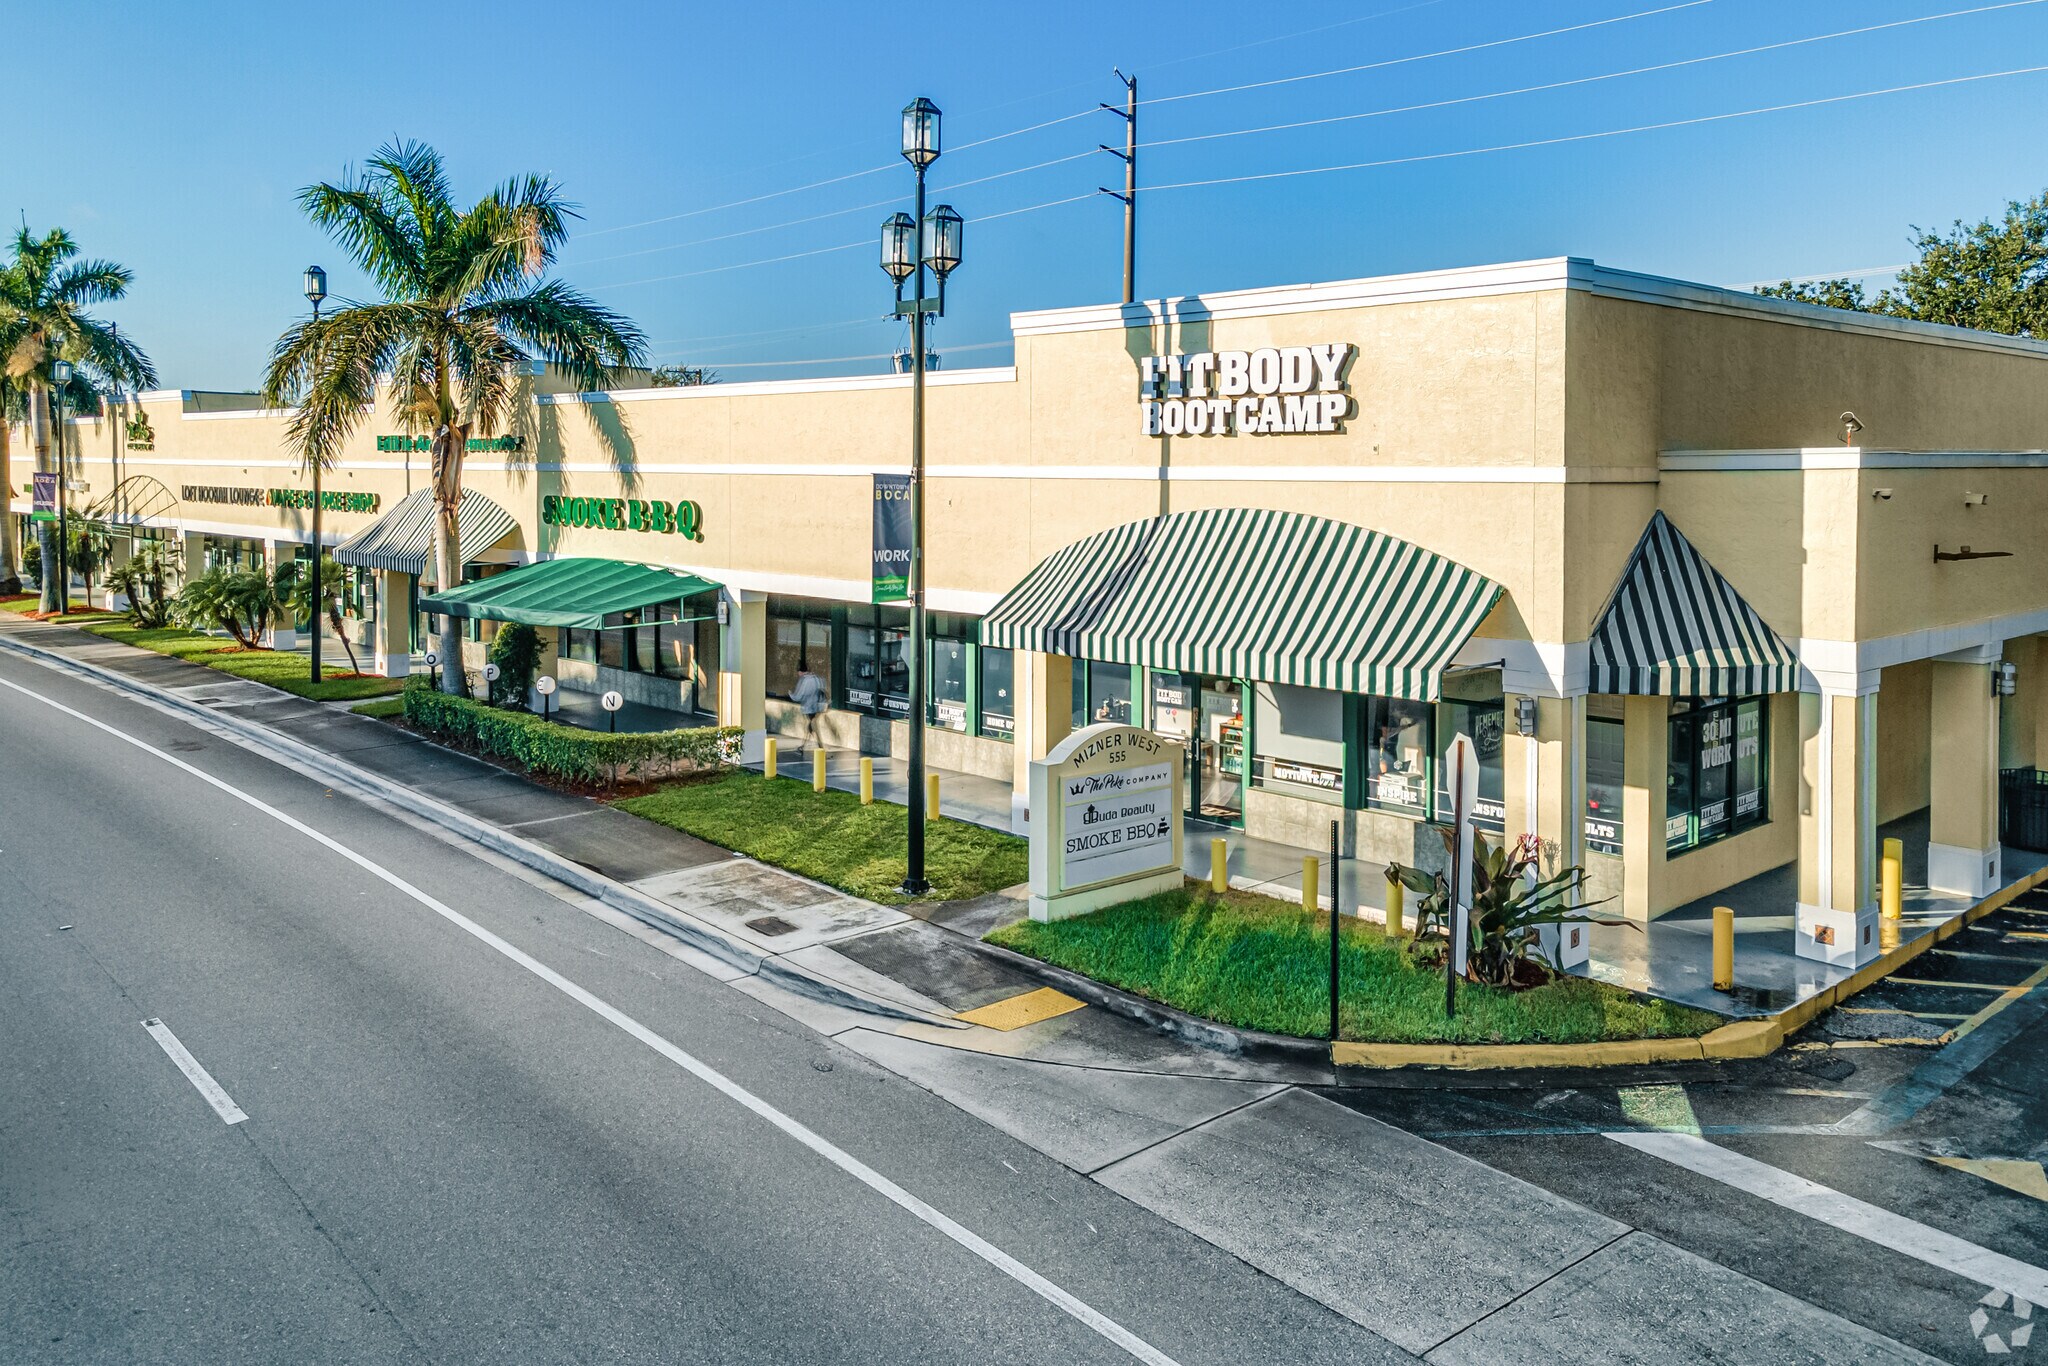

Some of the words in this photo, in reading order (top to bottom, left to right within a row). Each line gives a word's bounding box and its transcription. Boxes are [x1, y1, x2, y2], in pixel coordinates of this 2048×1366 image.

[1141, 353, 1214, 398] FIT
[1218, 343, 1348, 396] BODY
[1141, 399, 1232, 435] BOOT
[1235, 394, 1347, 433] CAMP
[376, 435, 413, 451] Edible
[415, 436, 519, 452] Arements
[181, 485, 197, 502] LOFT
[307, 490, 343, 511] SOKE
[345, 493, 375, 514] SHOP
[875, 490, 910, 500] BOCA
[542, 495, 619, 530] SMOKE
[873, 549, 911, 563] WORK
[486, 667, 494, 678] P
[605, 695, 616, 708] N
[987, 717, 1005, 728] HOME
[1703, 722, 1718, 743] 30
[1073, 734, 1122, 768] MIZNER
[1128, 733, 1161, 755] WEST
[1109, 750, 1126, 763] 555
[1085, 776, 1103, 793] The
[1126, 772, 1168, 785] COMPANY
[1378, 786, 1417, 803] INSPIRE
[1120, 803, 1155, 818] Beauty
[1066, 828, 1122, 854] SMOKE
[1126, 822, 1157, 841] BBQ
